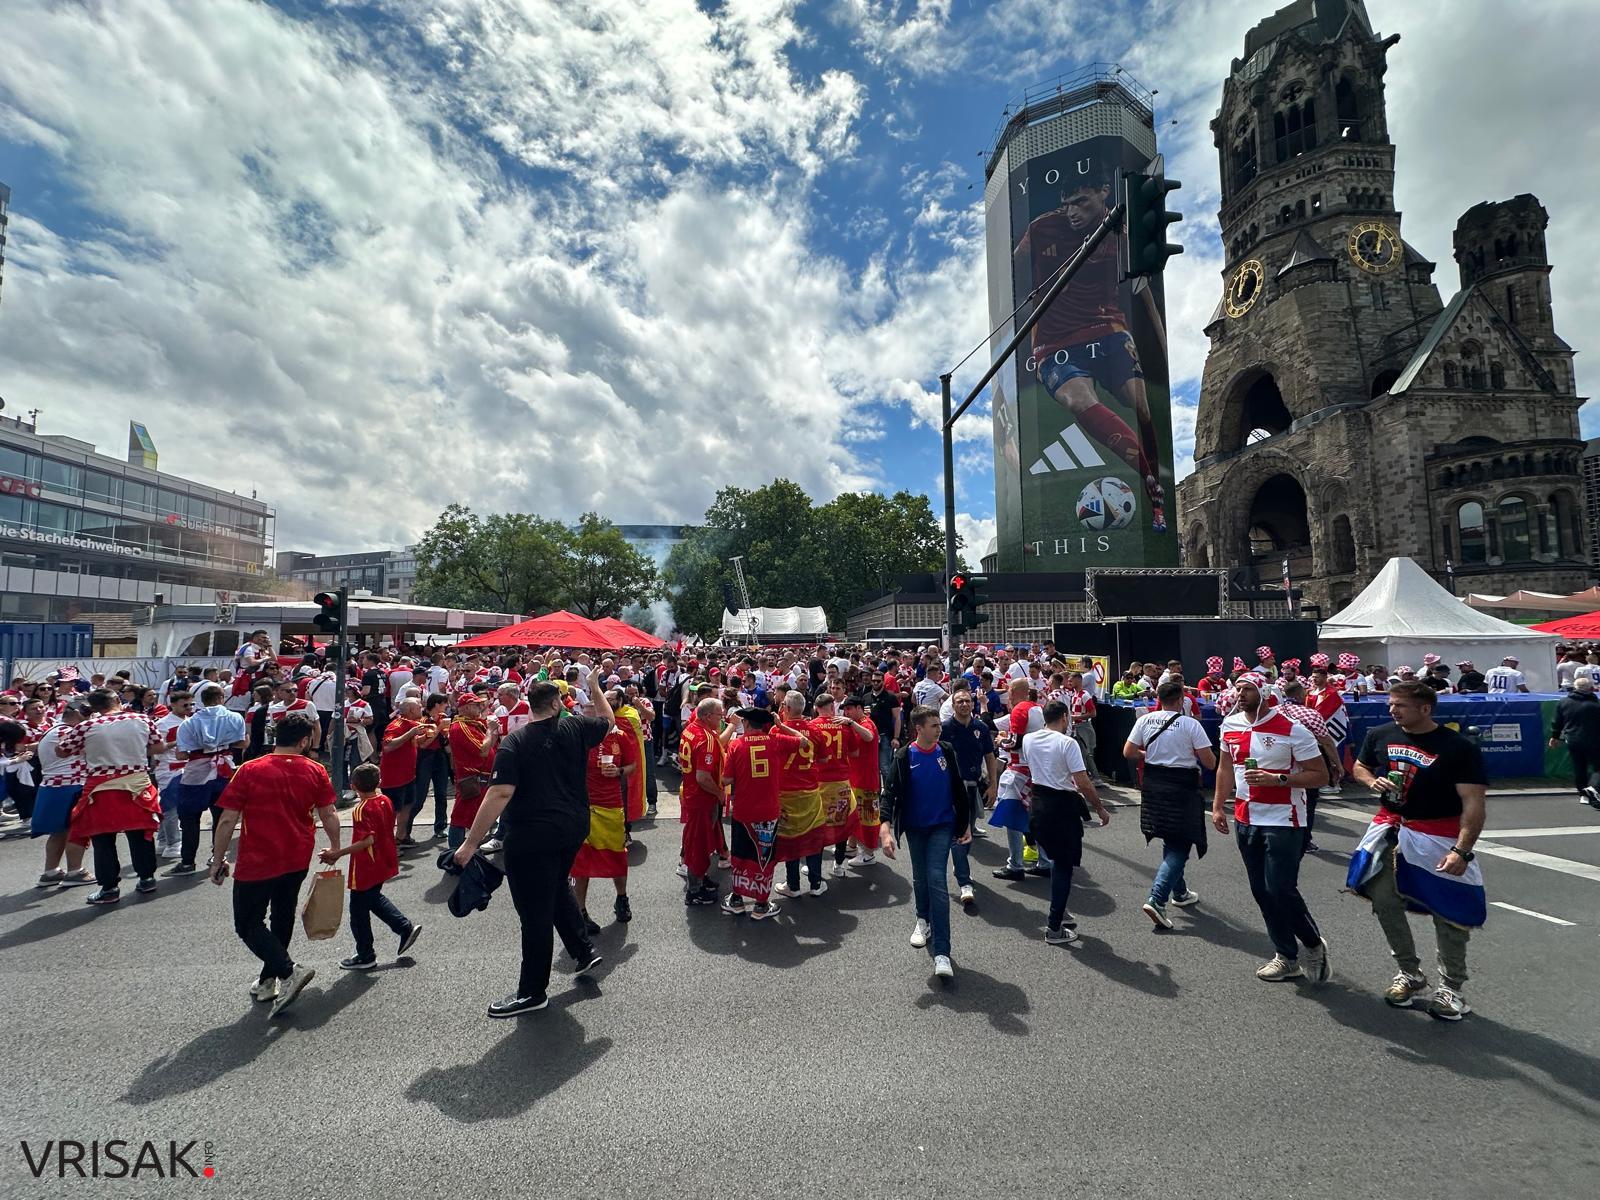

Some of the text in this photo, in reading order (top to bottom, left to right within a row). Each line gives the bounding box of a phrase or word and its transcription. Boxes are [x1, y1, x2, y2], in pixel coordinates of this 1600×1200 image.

[1018, 158, 1092, 195] YOU
[1026, 343, 1101, 372] GOT
[0, 525, 132, 556] ie Stachelschweine
[181, 518, 232, 537] SUPERFIT
[1032, 535, 1110, 557] THIS
[749, 745, 769, 778] 6
[1389, 748, 1424, 760] VUKOVAR
